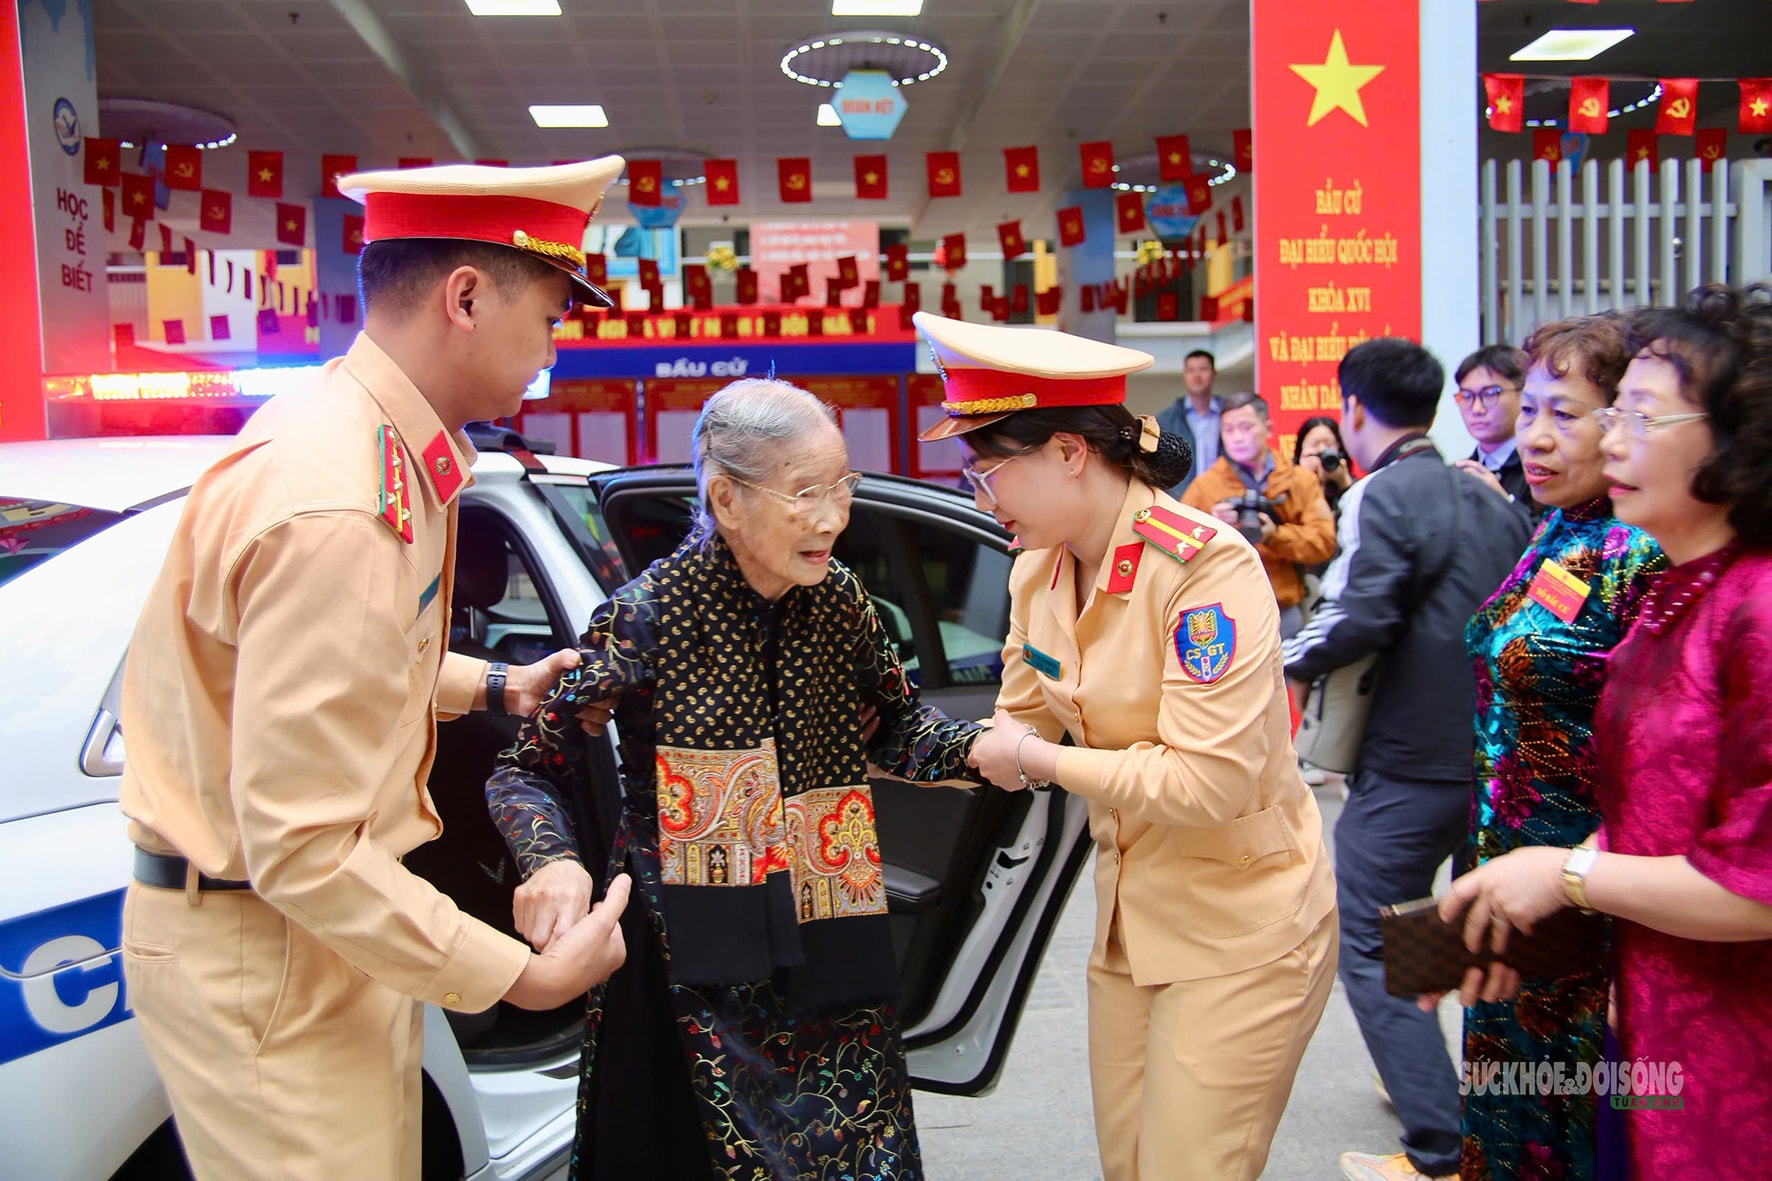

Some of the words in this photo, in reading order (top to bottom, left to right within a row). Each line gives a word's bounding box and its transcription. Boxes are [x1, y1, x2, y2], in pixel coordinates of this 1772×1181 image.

[56, 187, 88, 221] HỌC
[65, 222, 86, 255] ĐỂ
[1279, 238, 1303, 269] ĐẠI
[1305, 223, 1336, 263] BIỂU
[1337, 227, 1372, 265] QUỐC
[1374, 231, 1397, 269] HỘI
[61, 260, 93, 293] BIẾT
[1347, 287, 1371, 312] XVI
[1269, 330, 1289, 361] VÀ
[1290, 336, 1314, 367] ĐẠI
[1280, 378, 1318, 410] NHÂN
[1320, 378, 1341, 410] DÂ
